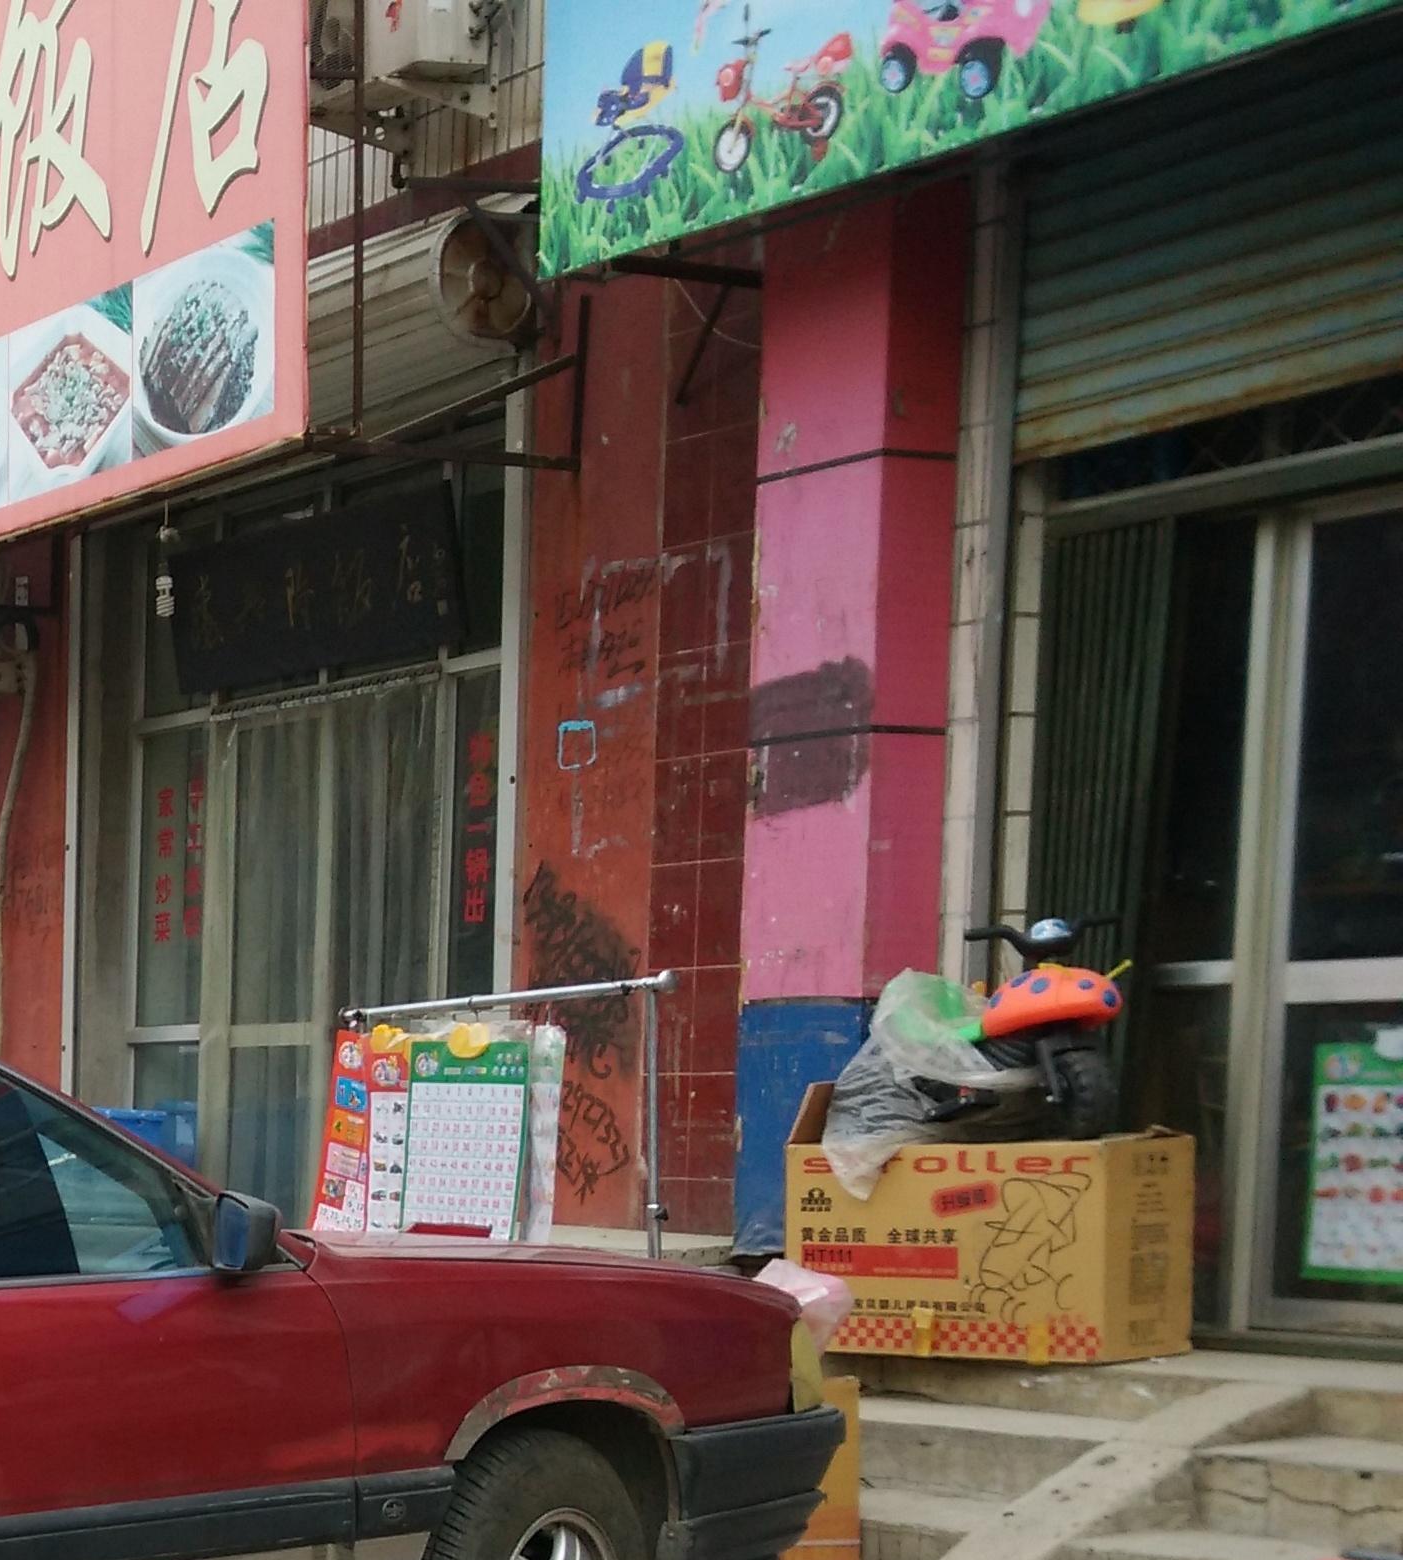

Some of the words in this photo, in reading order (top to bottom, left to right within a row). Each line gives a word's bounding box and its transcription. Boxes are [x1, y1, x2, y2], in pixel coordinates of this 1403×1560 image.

[154, 786, 176, 943] 家常炒菜
[803, 1150, 1092, 1175] sroller
[801, 1227, 867, 1244] 黄金品质
[887, 1227, 958, 1245] 全球共享
